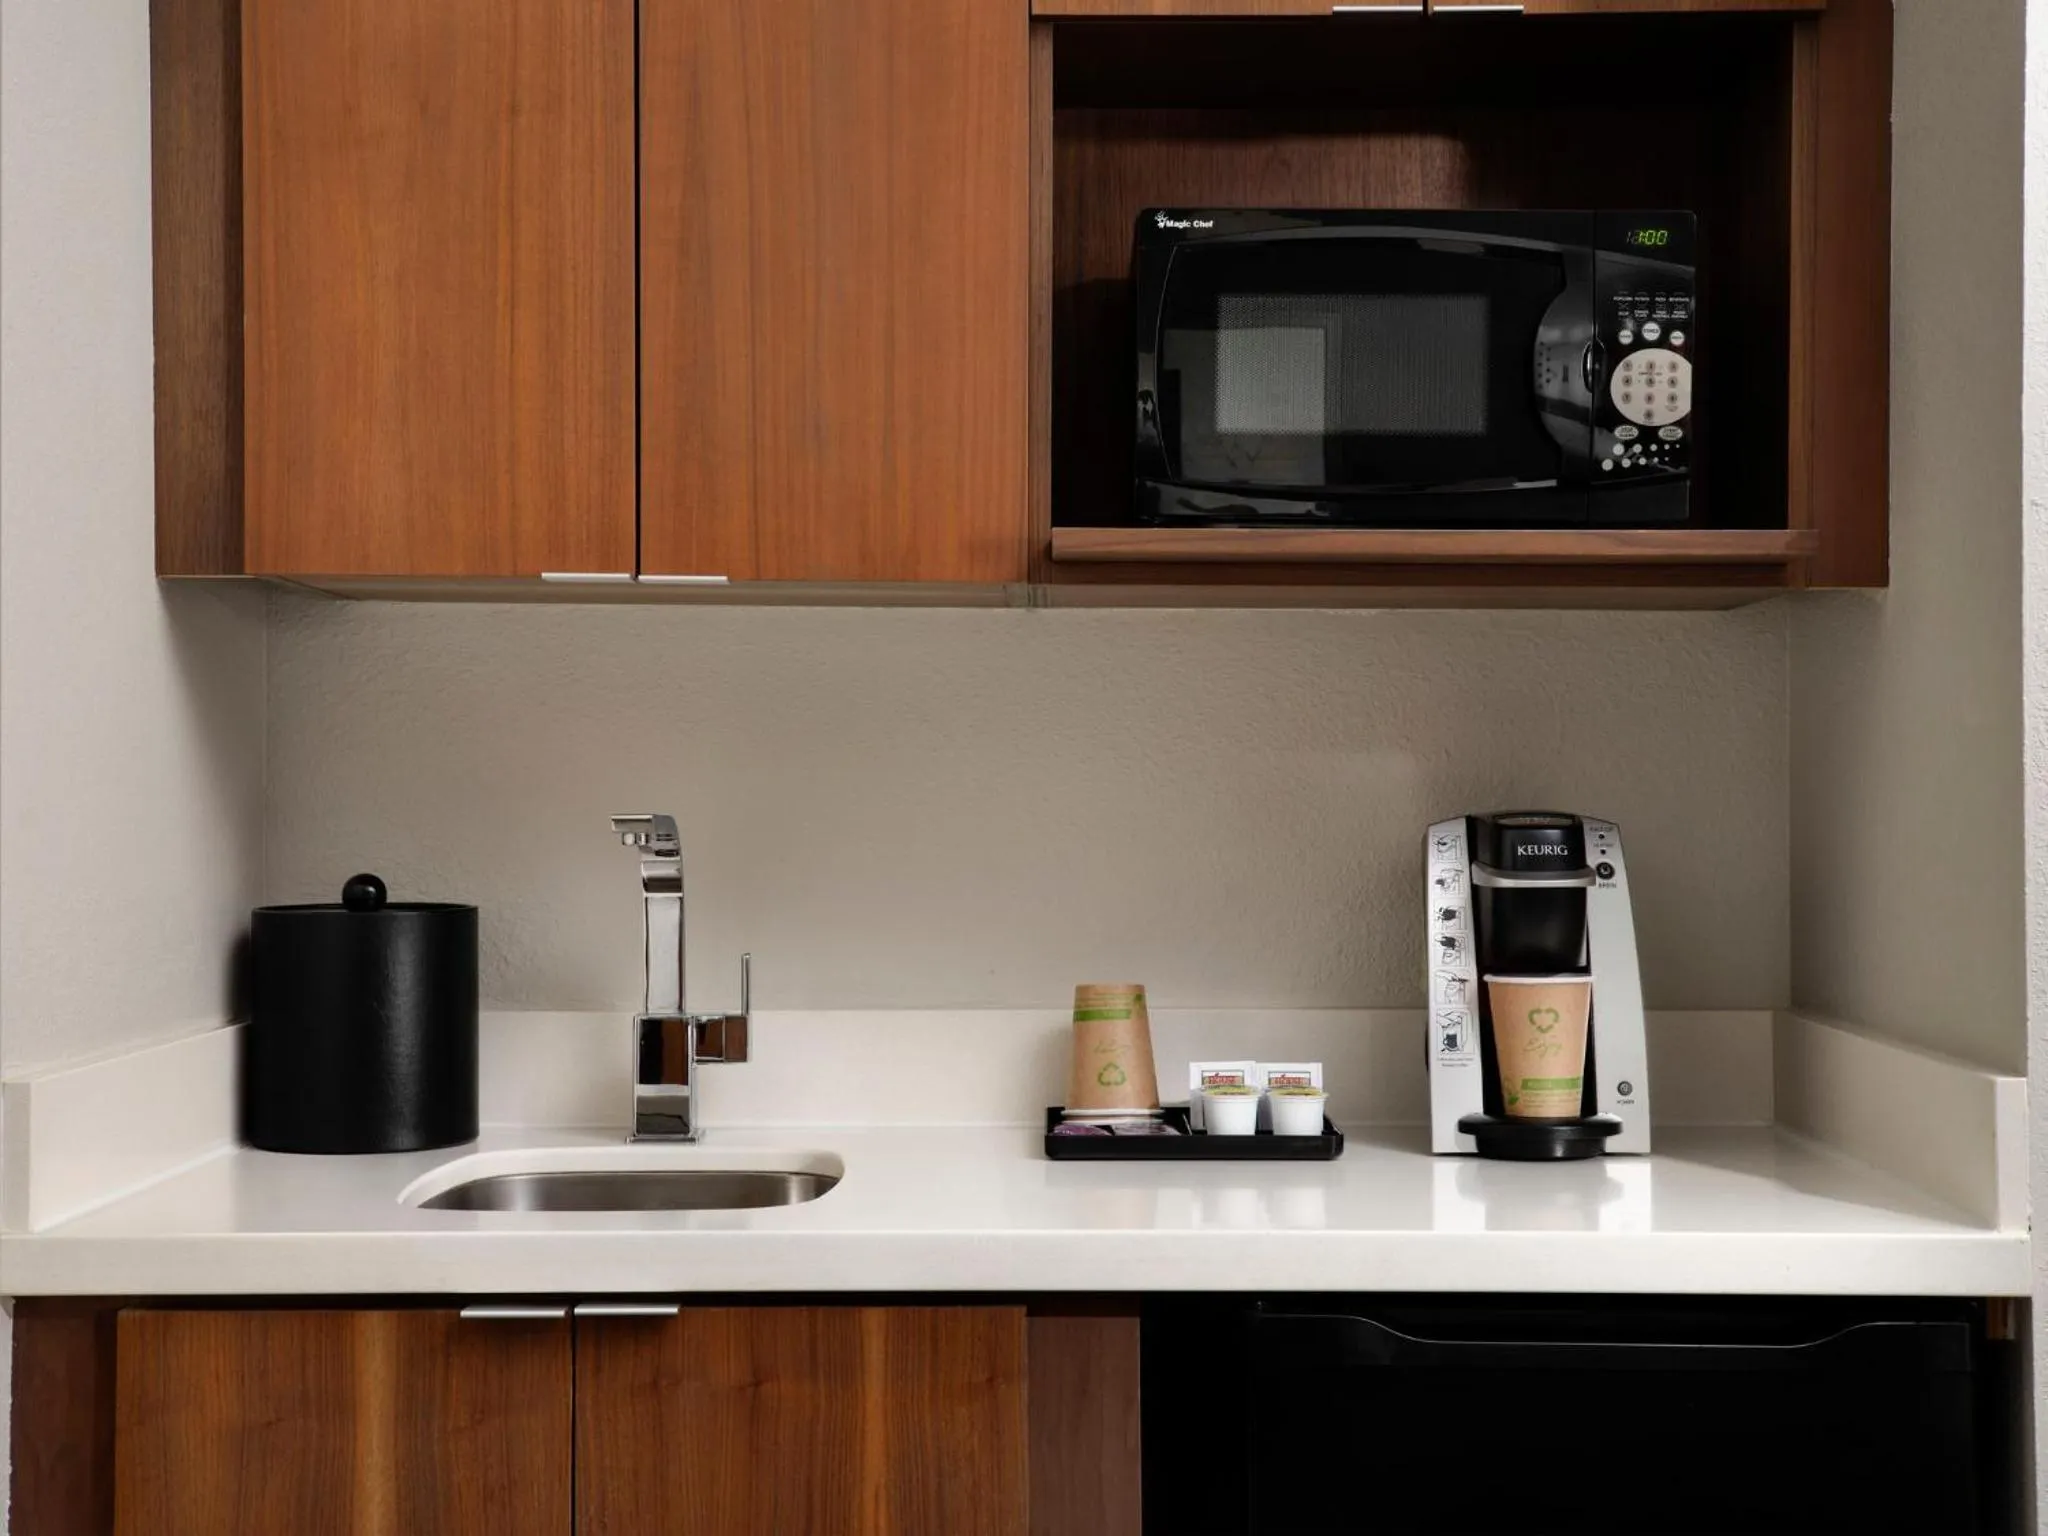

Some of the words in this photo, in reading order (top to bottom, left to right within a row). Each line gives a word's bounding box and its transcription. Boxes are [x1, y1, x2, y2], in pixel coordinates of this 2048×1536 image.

[1166, 219, 1192, 229] Magic
[1193, 219, 1214, 229] Chef
[1517, 844, 1569, 856] KEURIG
